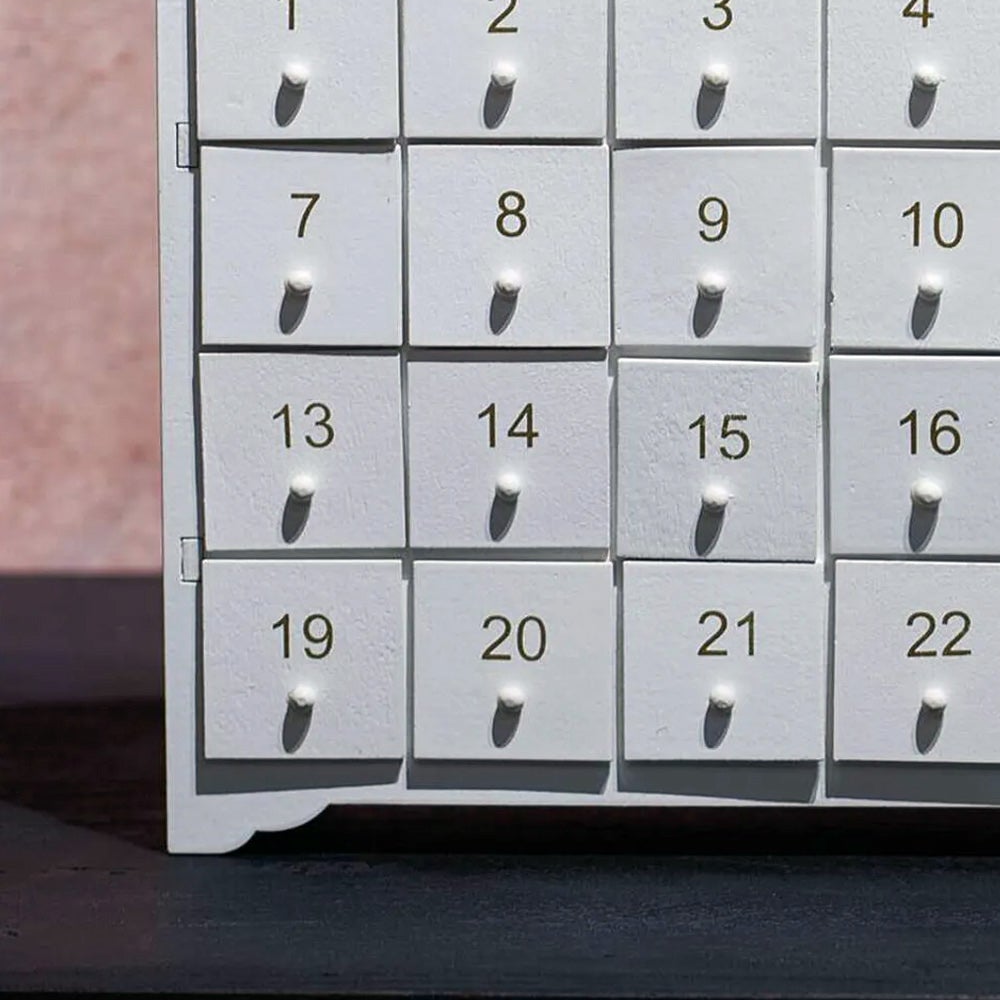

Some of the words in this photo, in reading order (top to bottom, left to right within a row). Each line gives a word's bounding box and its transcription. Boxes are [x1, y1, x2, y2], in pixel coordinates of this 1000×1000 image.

[290, 192, 321, 239] 7
[495, 190, 528, 238] 8
[697, 196, 729, 243] 9
[901, 201, 964, 249] 10
[272, 402, 335, 449] 13
[477, 402, 540, 449] 14
[688, 413, 750, 461] 15
[899, 408, 961, 456] 16
[272, 613, 334, 660] 19
[481, 614, 547, 662] 20
[697, 610, 755, 657] 21
[906, 610, 972, 658] 22
